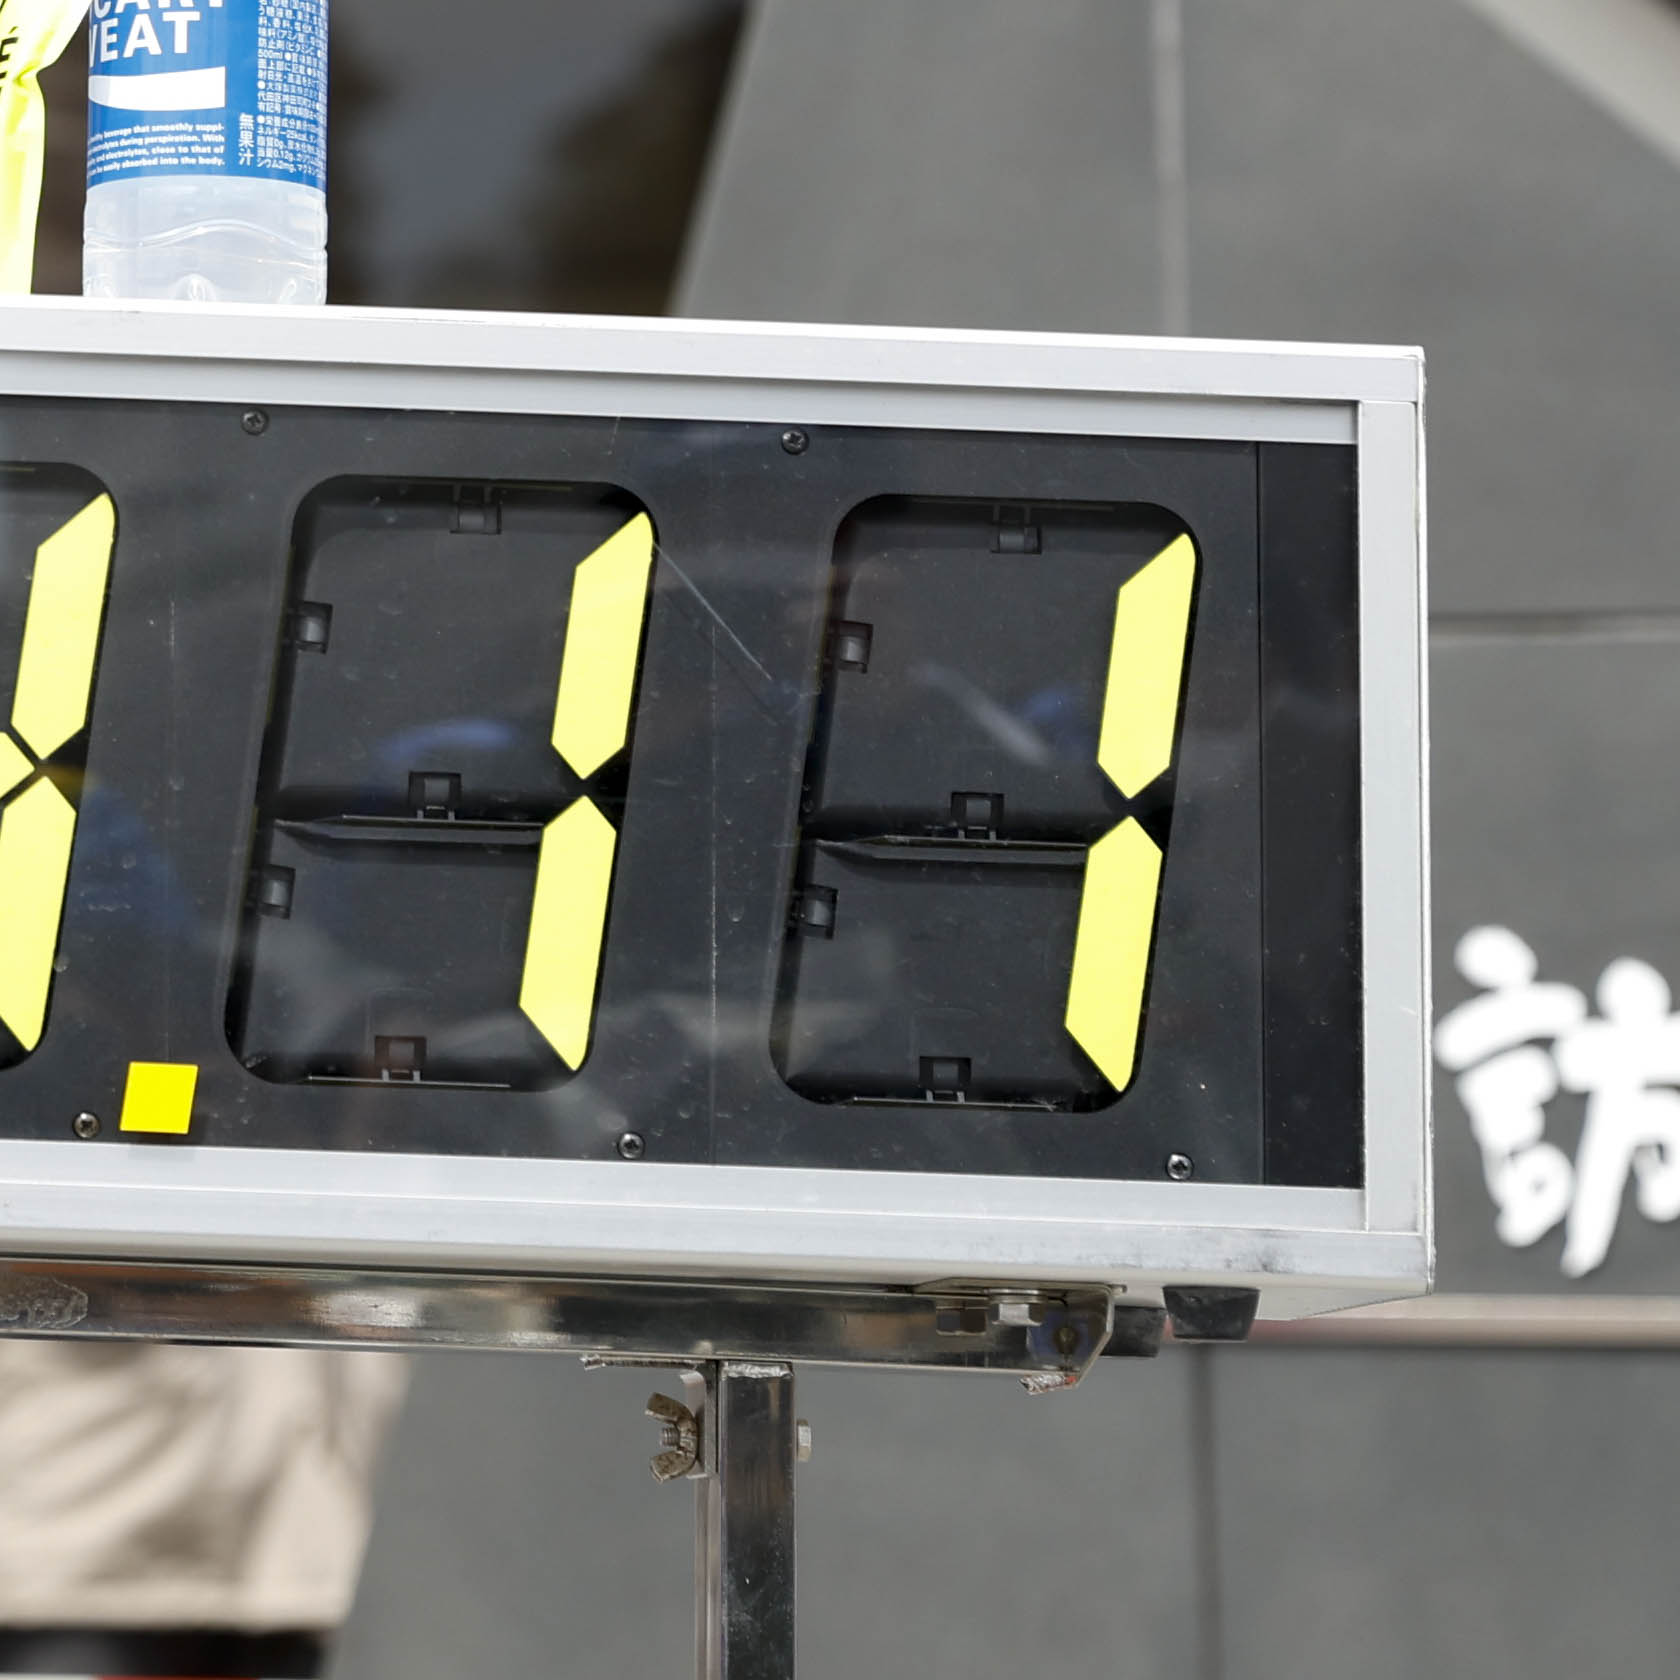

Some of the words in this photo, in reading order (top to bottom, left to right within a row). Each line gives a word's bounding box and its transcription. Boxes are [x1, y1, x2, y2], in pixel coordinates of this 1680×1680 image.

[202, 133, 224, 142] With
[238, 113, 255, 166] 無果汁
[191, 145, 211, 153] that
[213, 145, 224, 153] of
[160, 156, 178, 165] into
[180, 156, 196, 165] the
[198, 156, 225, 166] body.
